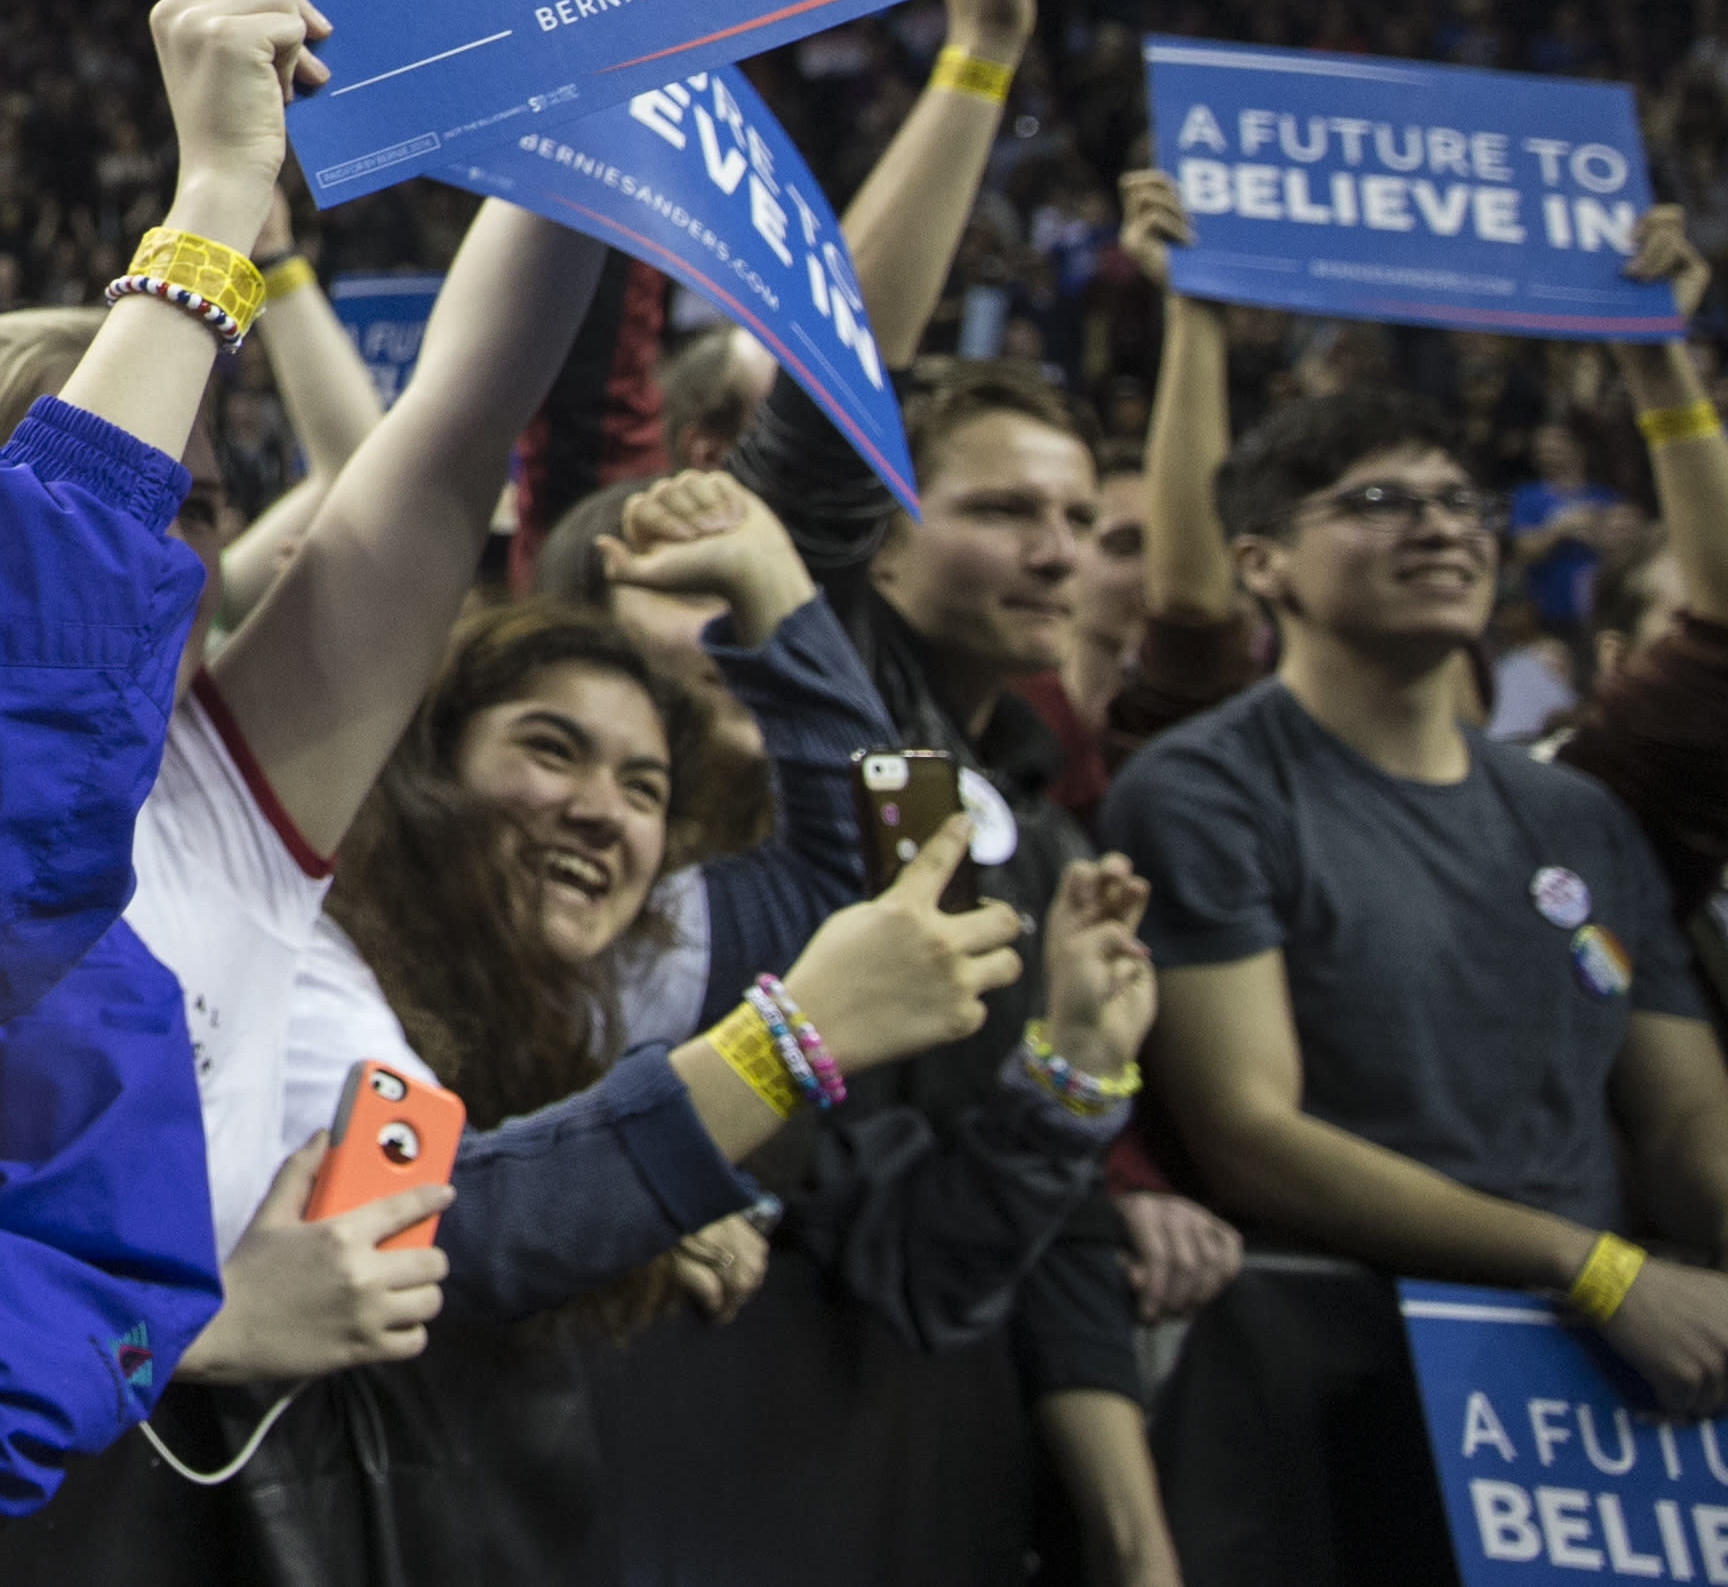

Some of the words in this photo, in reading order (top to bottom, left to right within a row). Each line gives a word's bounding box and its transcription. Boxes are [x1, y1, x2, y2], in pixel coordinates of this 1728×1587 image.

[1178, 105, 1226, 153] A
[1239, 109, 1514, 182] FUTURE
[1522, 138, 1628, 194] TO
[1178, 157, 1527, 244] BELIEVE
[1546, 195, 1637, 255] IN
[807, 251, 884, 393] IN
[1462, 1391, 1518, 1463] A
